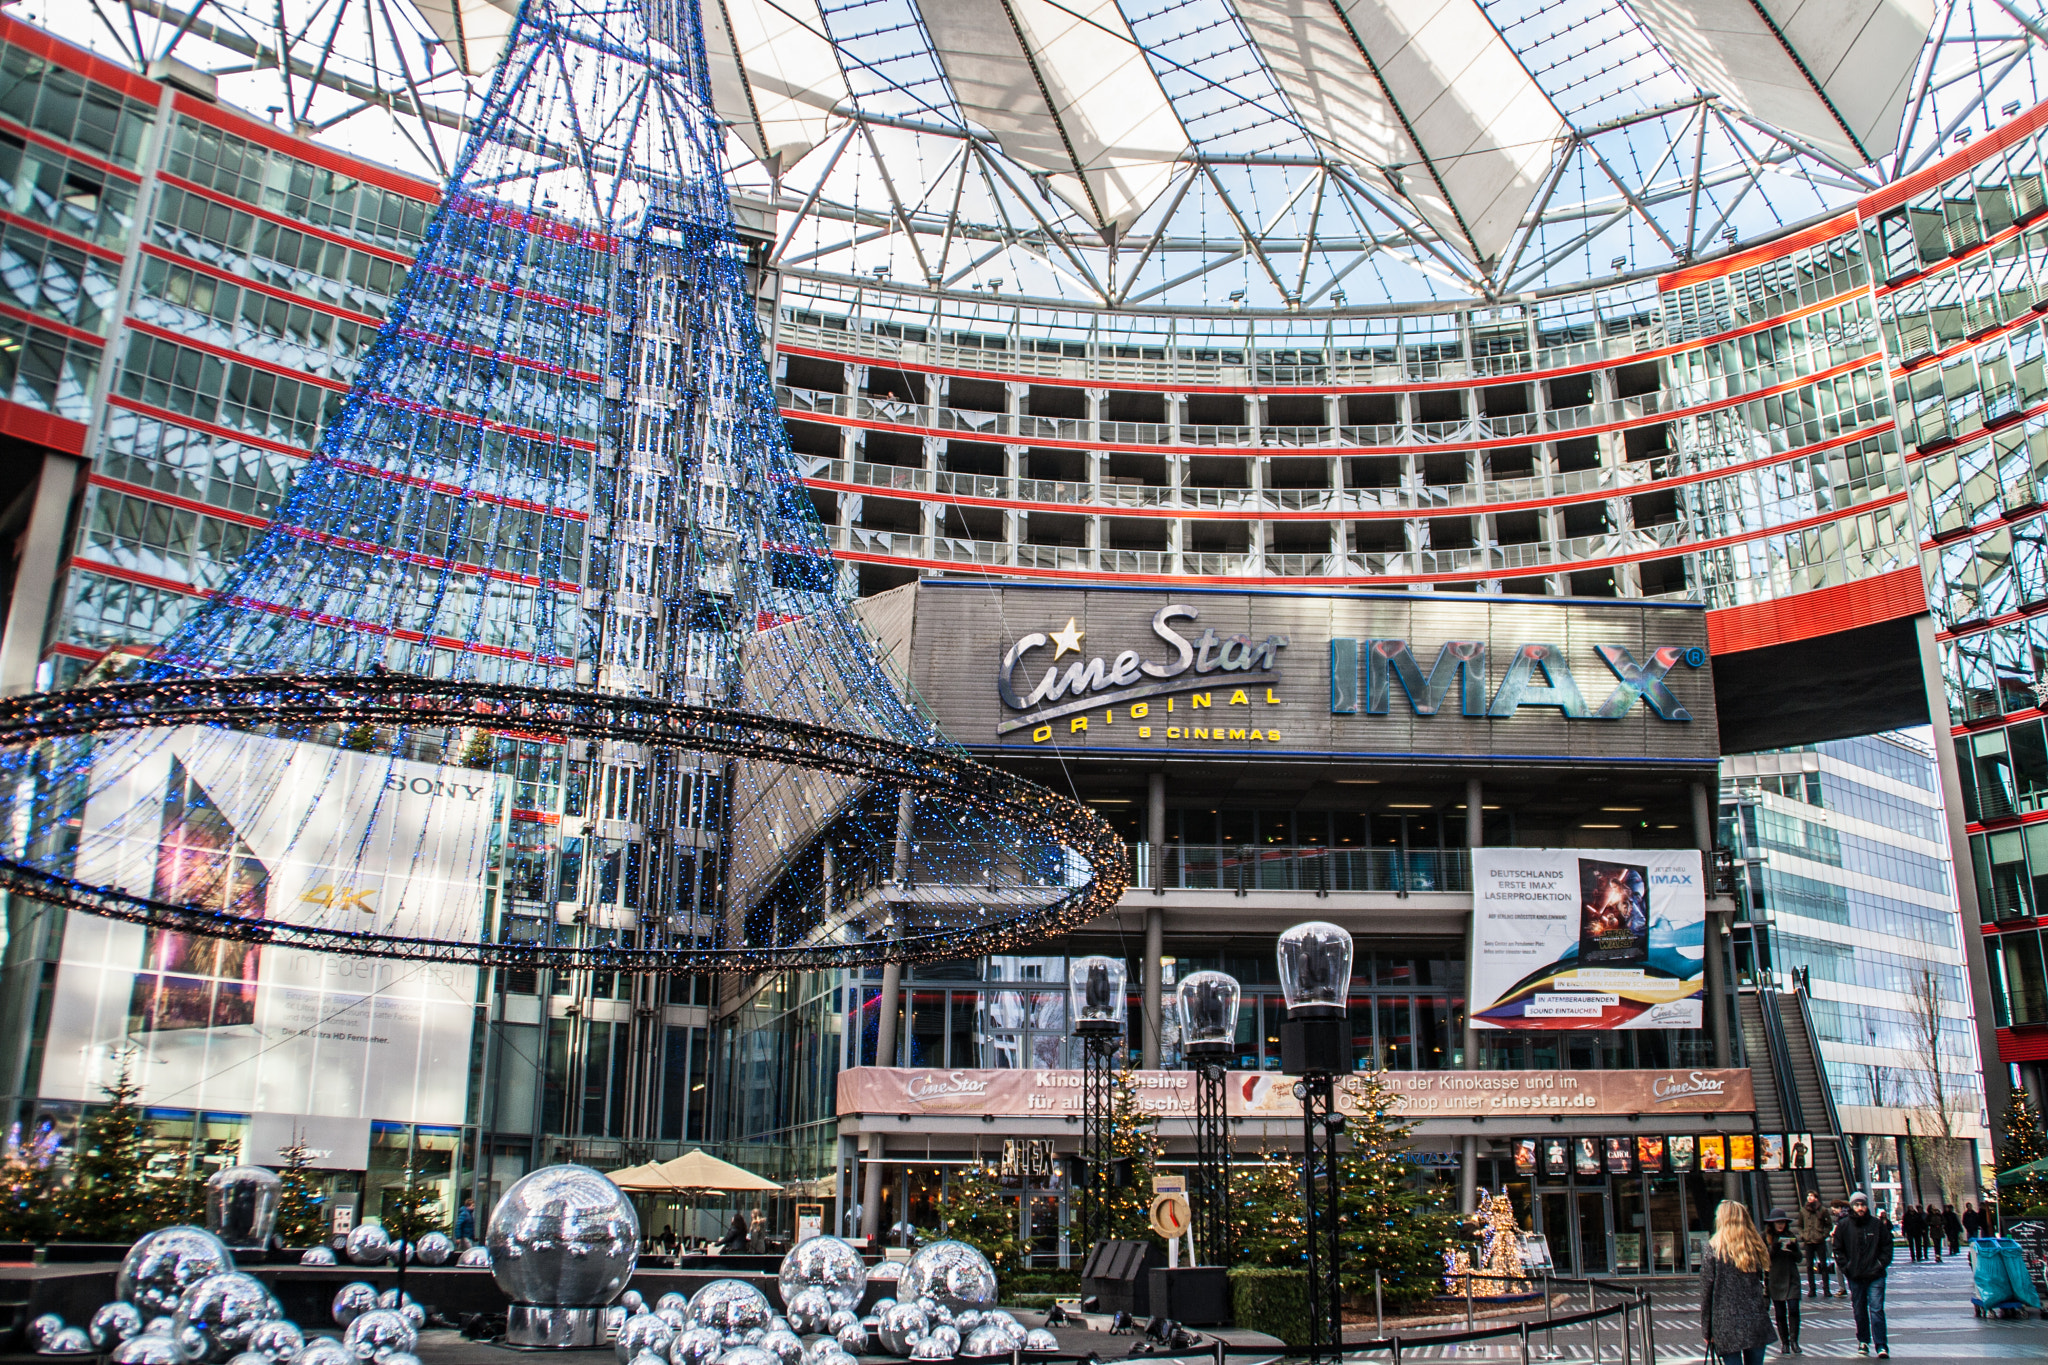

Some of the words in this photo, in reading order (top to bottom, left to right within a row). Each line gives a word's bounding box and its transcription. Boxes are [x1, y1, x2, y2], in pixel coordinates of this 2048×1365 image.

[998, 604, 1290, 710] CineStar
[1033, 688, 1281, 743] ORIGINAL
[1138, 727, 1151, 739] 8
[1167, 727, 1281, 742] CINEMAS
[386, 774, 484, 802] SONY
[1490, 869, 1564, 879] DEUTSCHLANDS
[1499, 881, 1526, 889] ERSTE
[298, 883, 377, 914] 4K
[1485, 891, 1572, 901] LASERPROJEKTION
[1408, 1076, 1433, 1090] der
[1439, 1076, 1520, 1090] Kinokasse
[1525, 1075, 1554, 1089] und
[1560, 1075, 1578, 1088] im
[1028, 1094, 1056, 1109] für
[1444, 1095, 1485, 1109] unter
[1491, 1093, 1597, 1108] cinestar.de
[1607, 1151, 1632, 1159] CAROL
